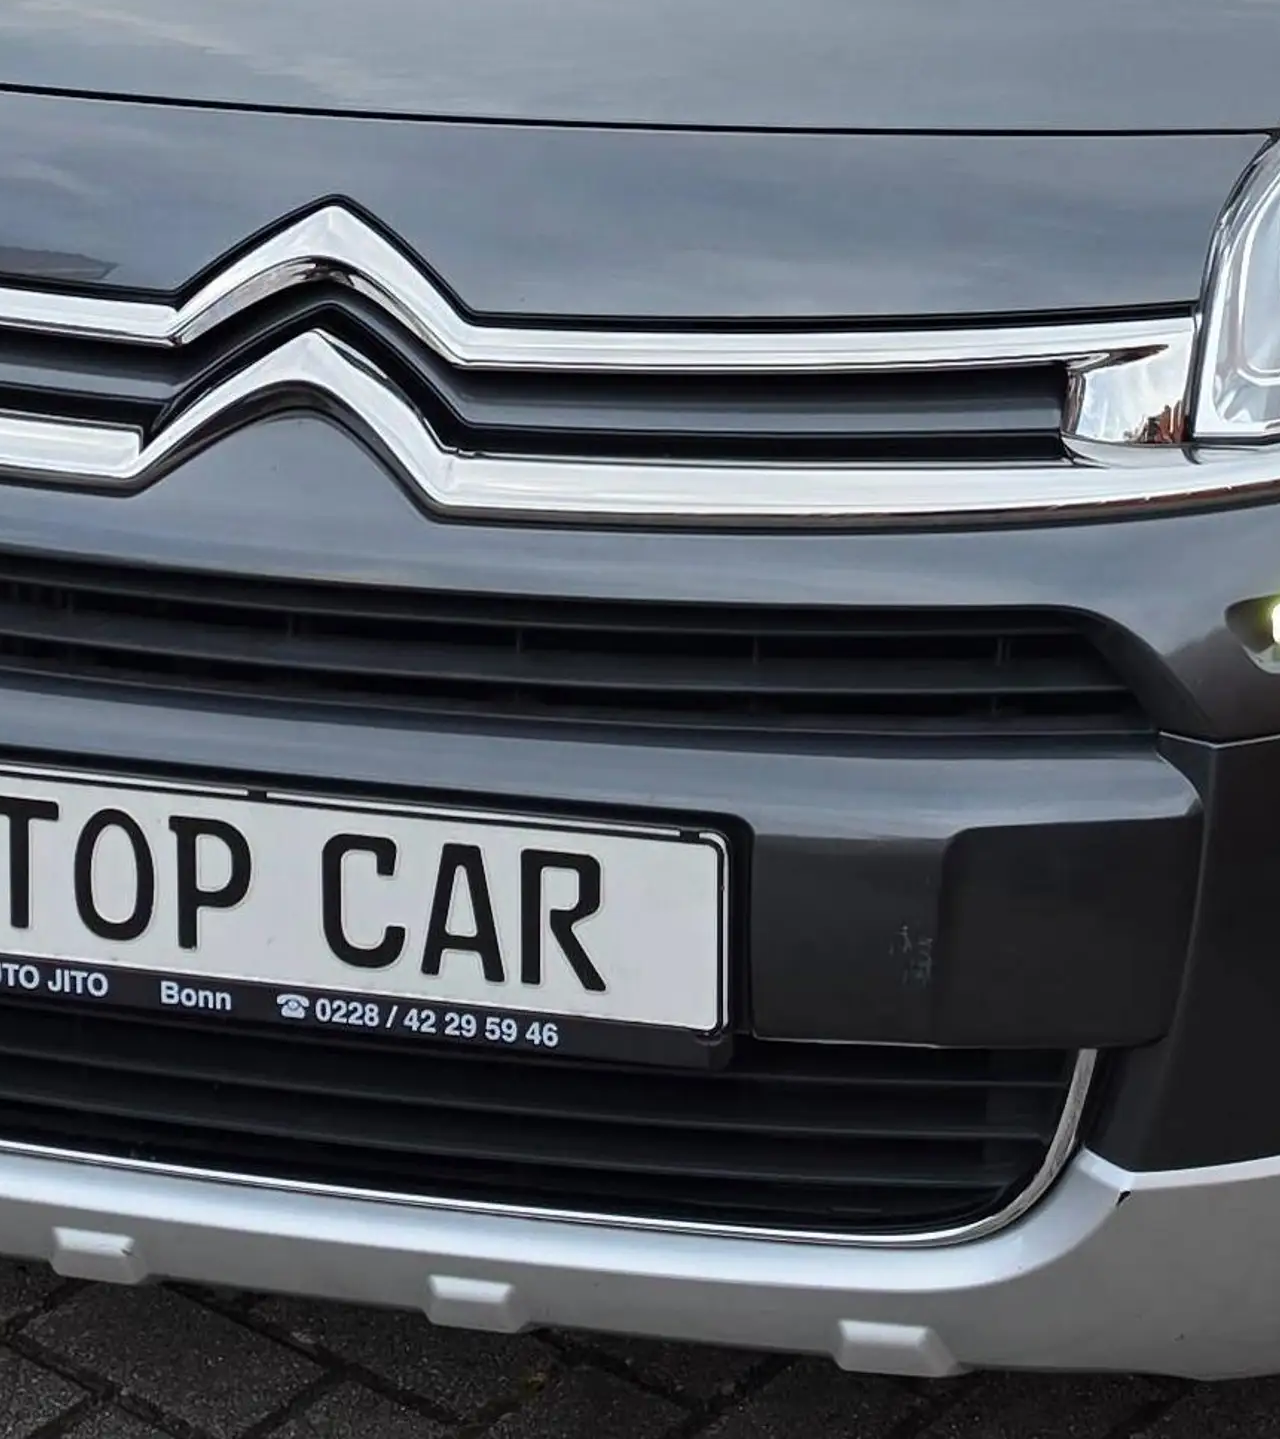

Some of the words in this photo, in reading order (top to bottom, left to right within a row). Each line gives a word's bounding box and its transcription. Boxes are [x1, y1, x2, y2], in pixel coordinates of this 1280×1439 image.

[322, 833, 608, 992] CAR
[47, 968, 109, 998] JITO
[160, 980, 232, 1011] Bonn
[315, 997, 380, 1028] 0228
[403, 1008, 437, 1034] 42
[444, 1012, 477, 1038] 29
[484, 1016, 518, 1043] 59
[525, 1021, 559, 1048] 46
